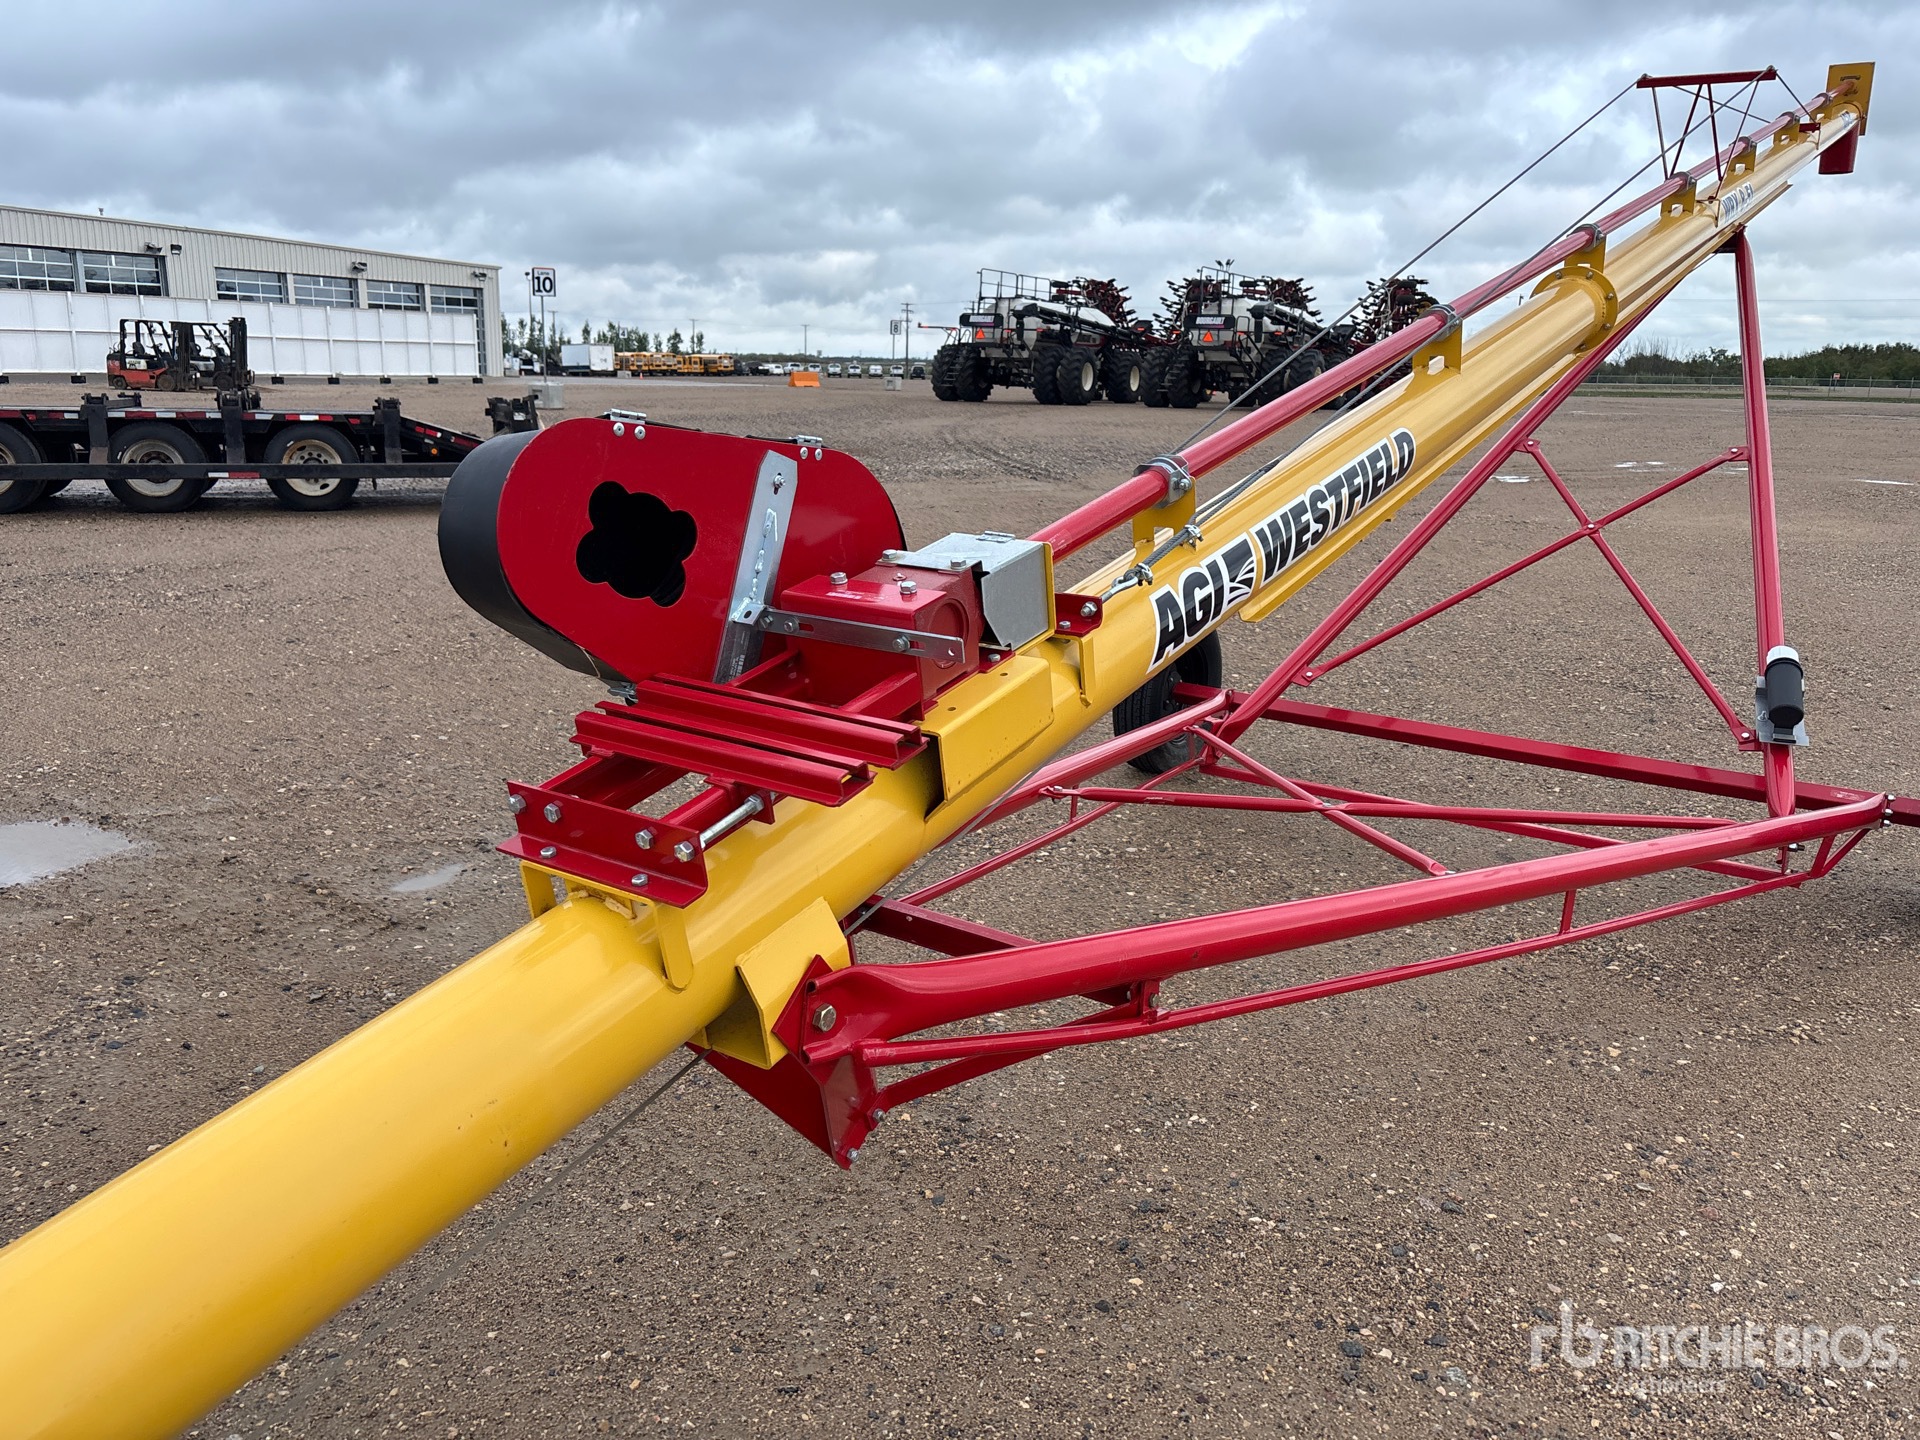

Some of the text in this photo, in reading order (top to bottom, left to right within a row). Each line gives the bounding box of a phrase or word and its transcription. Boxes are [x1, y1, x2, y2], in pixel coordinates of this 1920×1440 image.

[535, 276, 553, 293] 10
[893, 324, 899, 334] 8
[1151, 432, 1416, 665] AGI WESTFIELD
